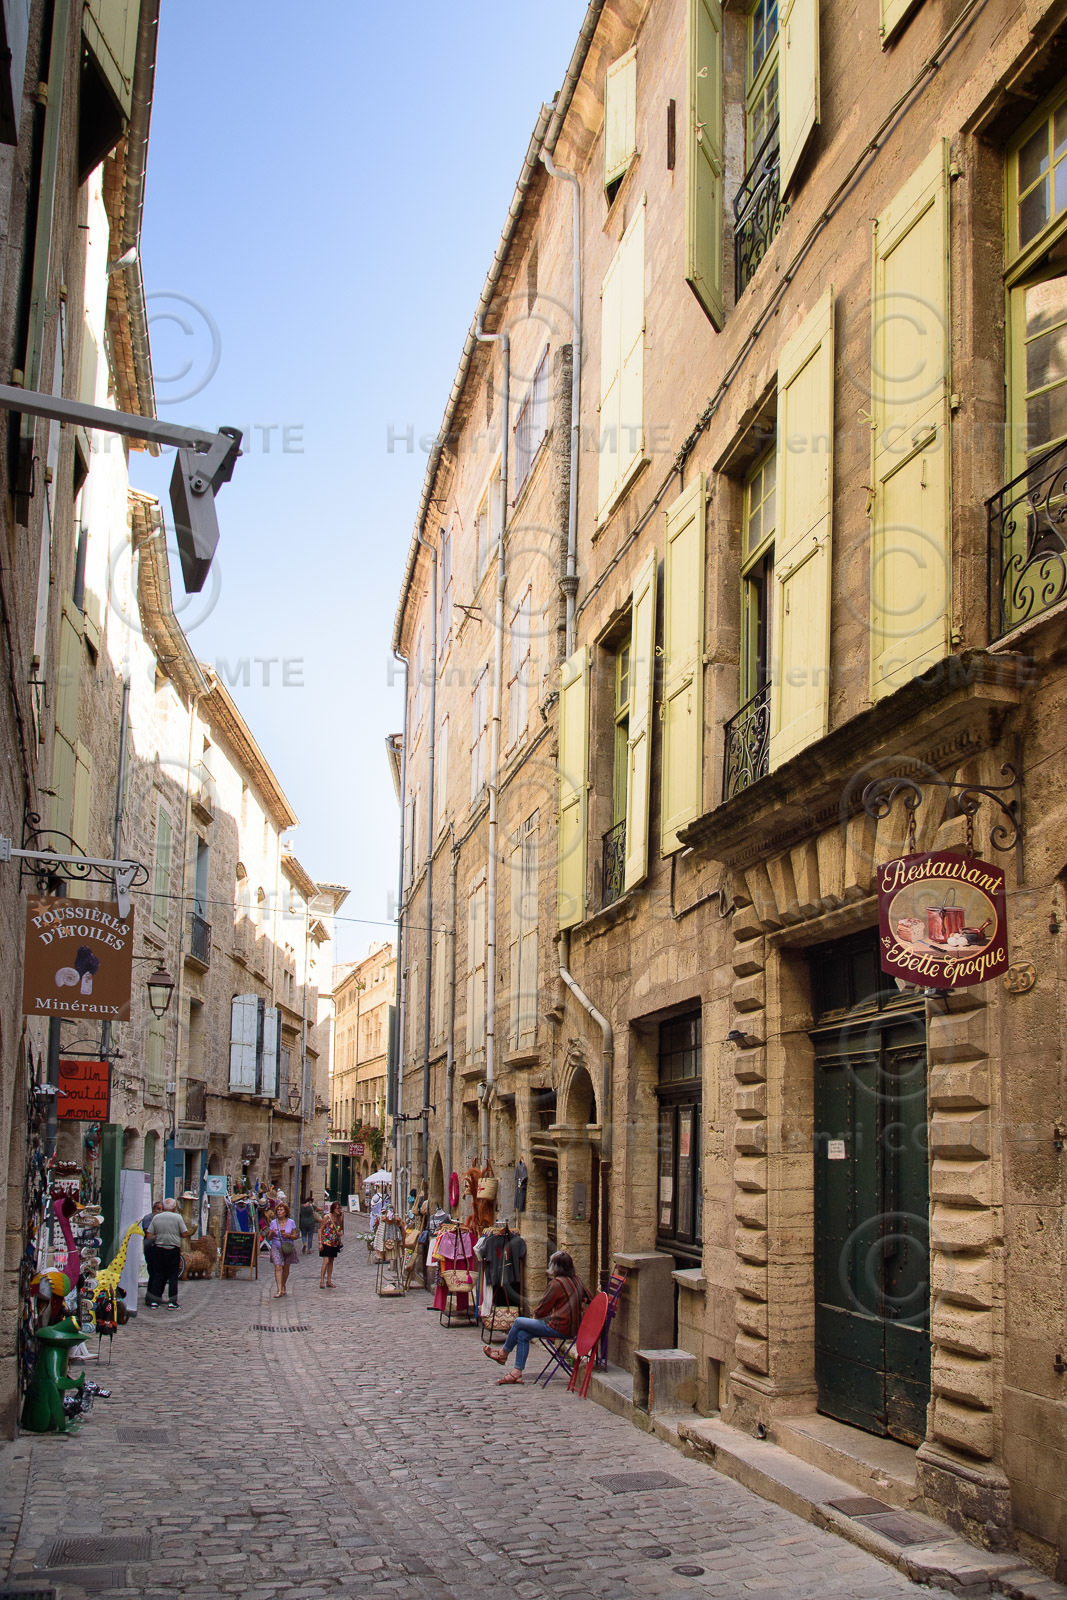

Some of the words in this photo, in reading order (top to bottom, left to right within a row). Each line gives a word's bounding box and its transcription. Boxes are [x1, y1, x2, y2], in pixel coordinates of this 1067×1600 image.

[881, 858, 1003, 896] Restaurant
[31, 907, 131, 936] POUSSIÈRES
[39, 924, 125, 951] D'ÉTOILES
[886, 942, 940, 978] Belle
[35, 997, 120, 1014] Minéraux
[84, 1066, 100, 1081] Un
[63, 1084, 89, 1100] bout
[95, 1085, 107, 1100] du
[65, 1104, 102, 1119] monde
